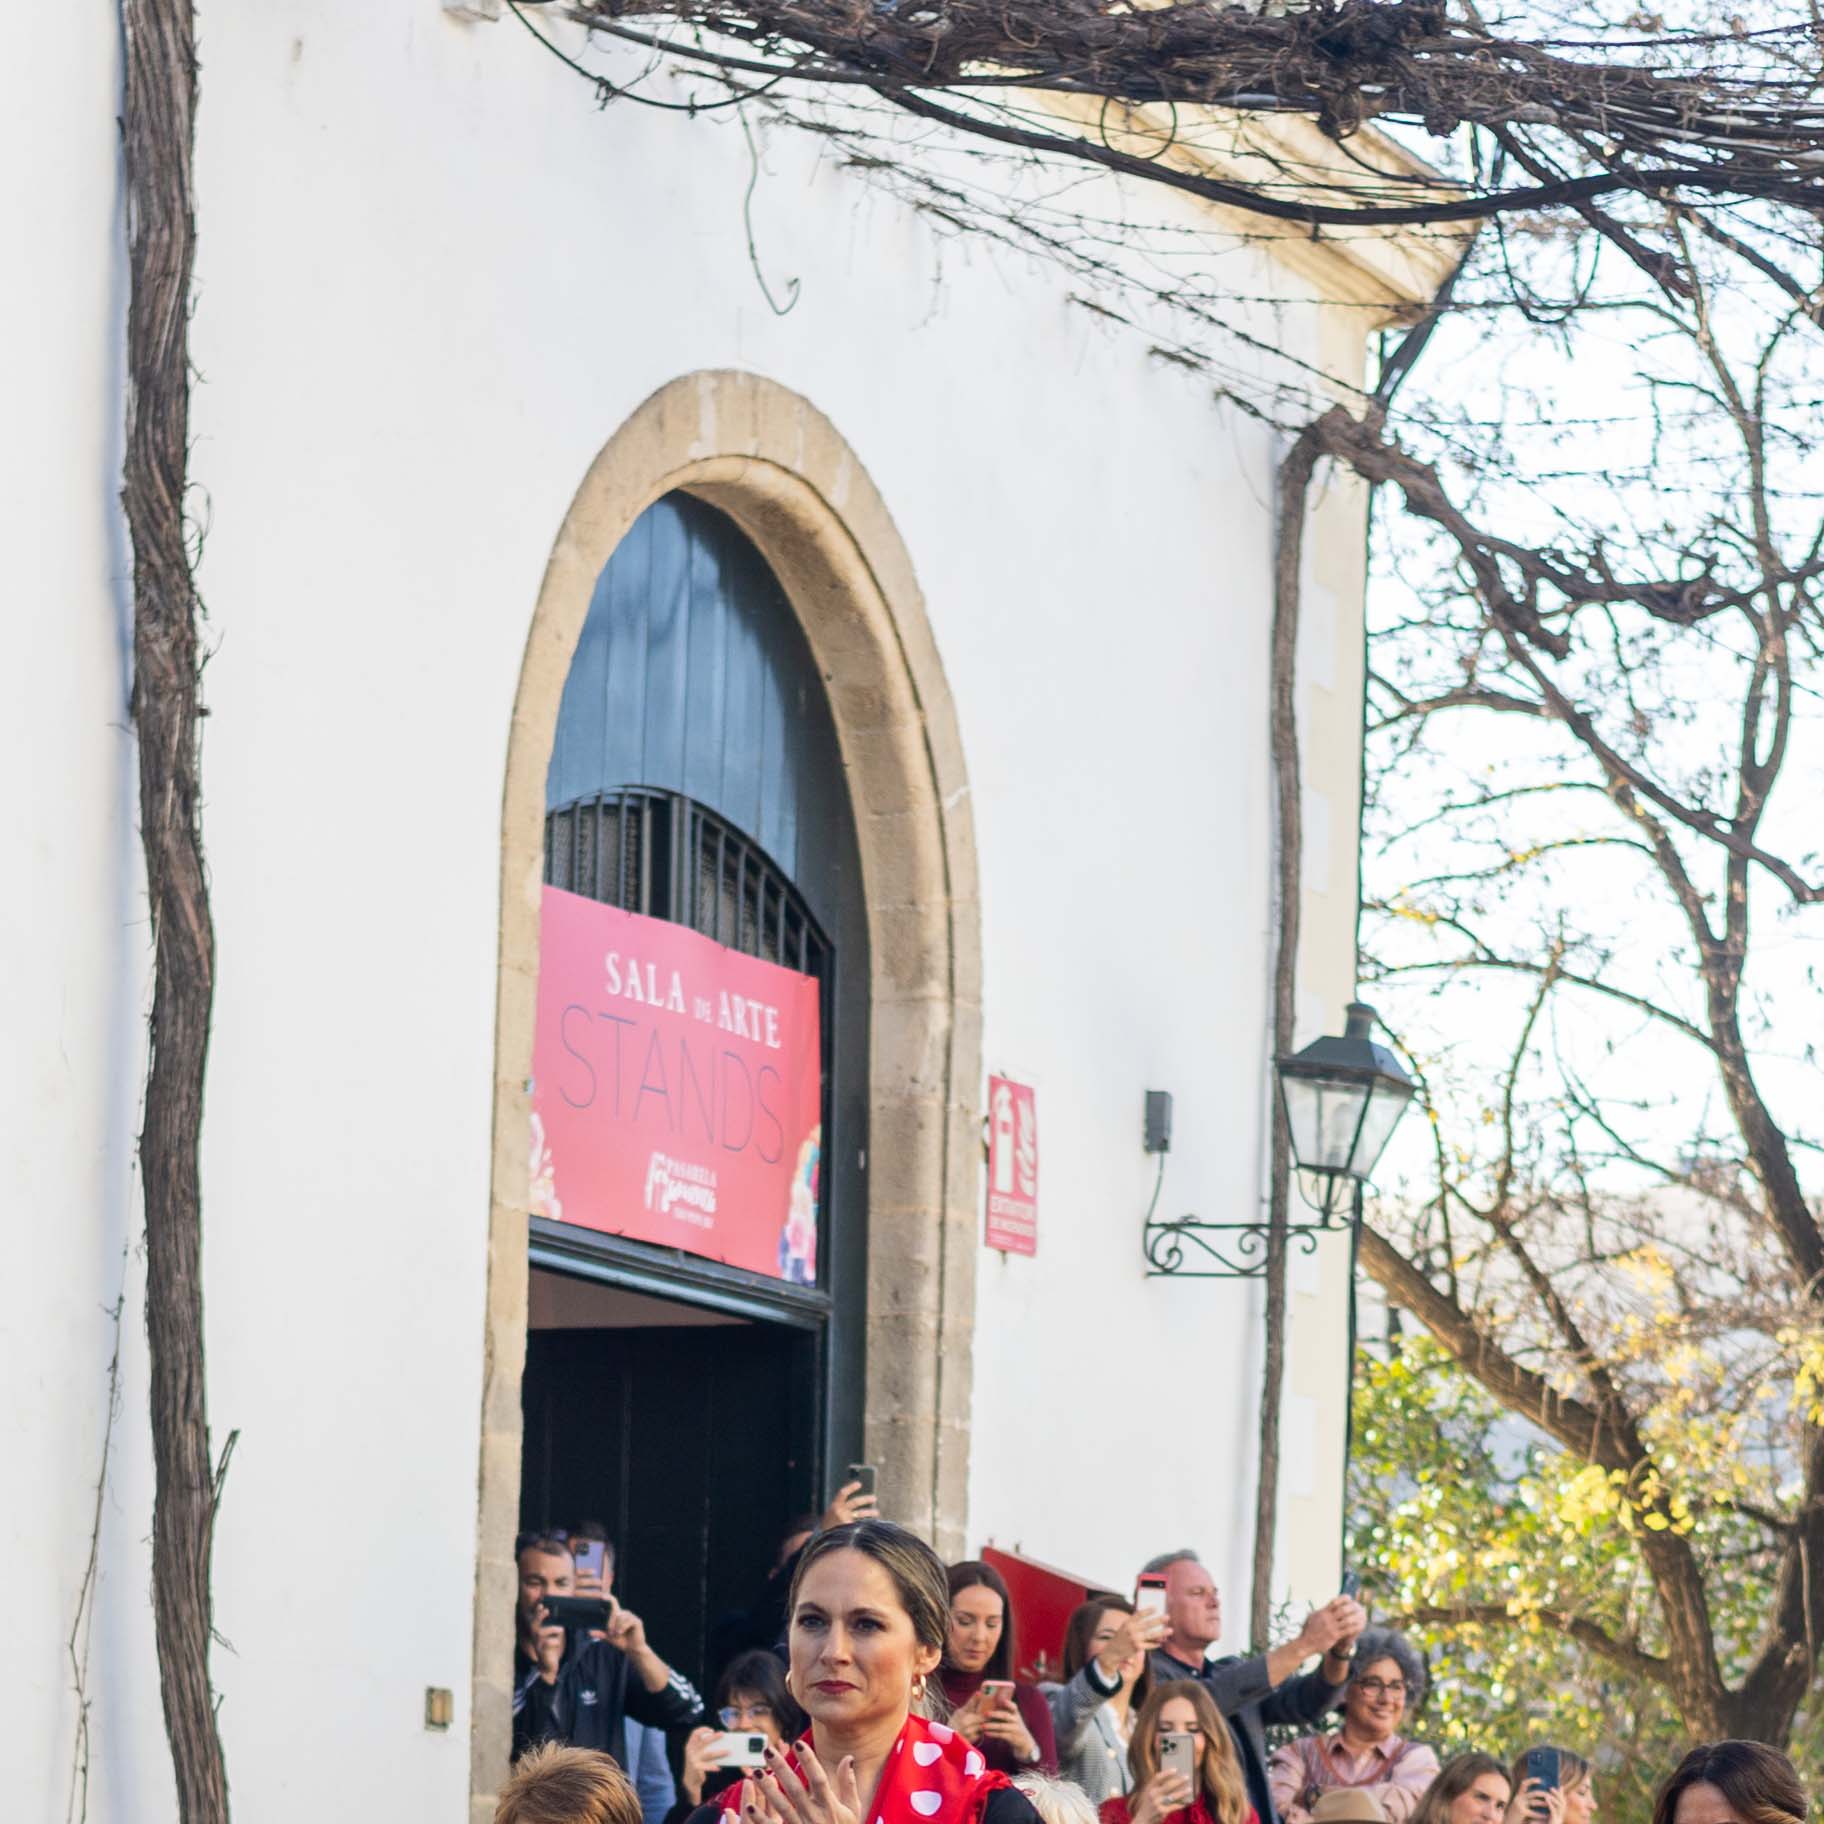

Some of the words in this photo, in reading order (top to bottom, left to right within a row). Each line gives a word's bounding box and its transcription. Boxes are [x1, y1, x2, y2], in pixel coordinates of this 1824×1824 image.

[605, 952, 687, 1014] SALA
[694, 996, 713, 1023] DE
[716, 988, 782, 1049] ARTE
[559, 1003, 785, 1165] STANDS
